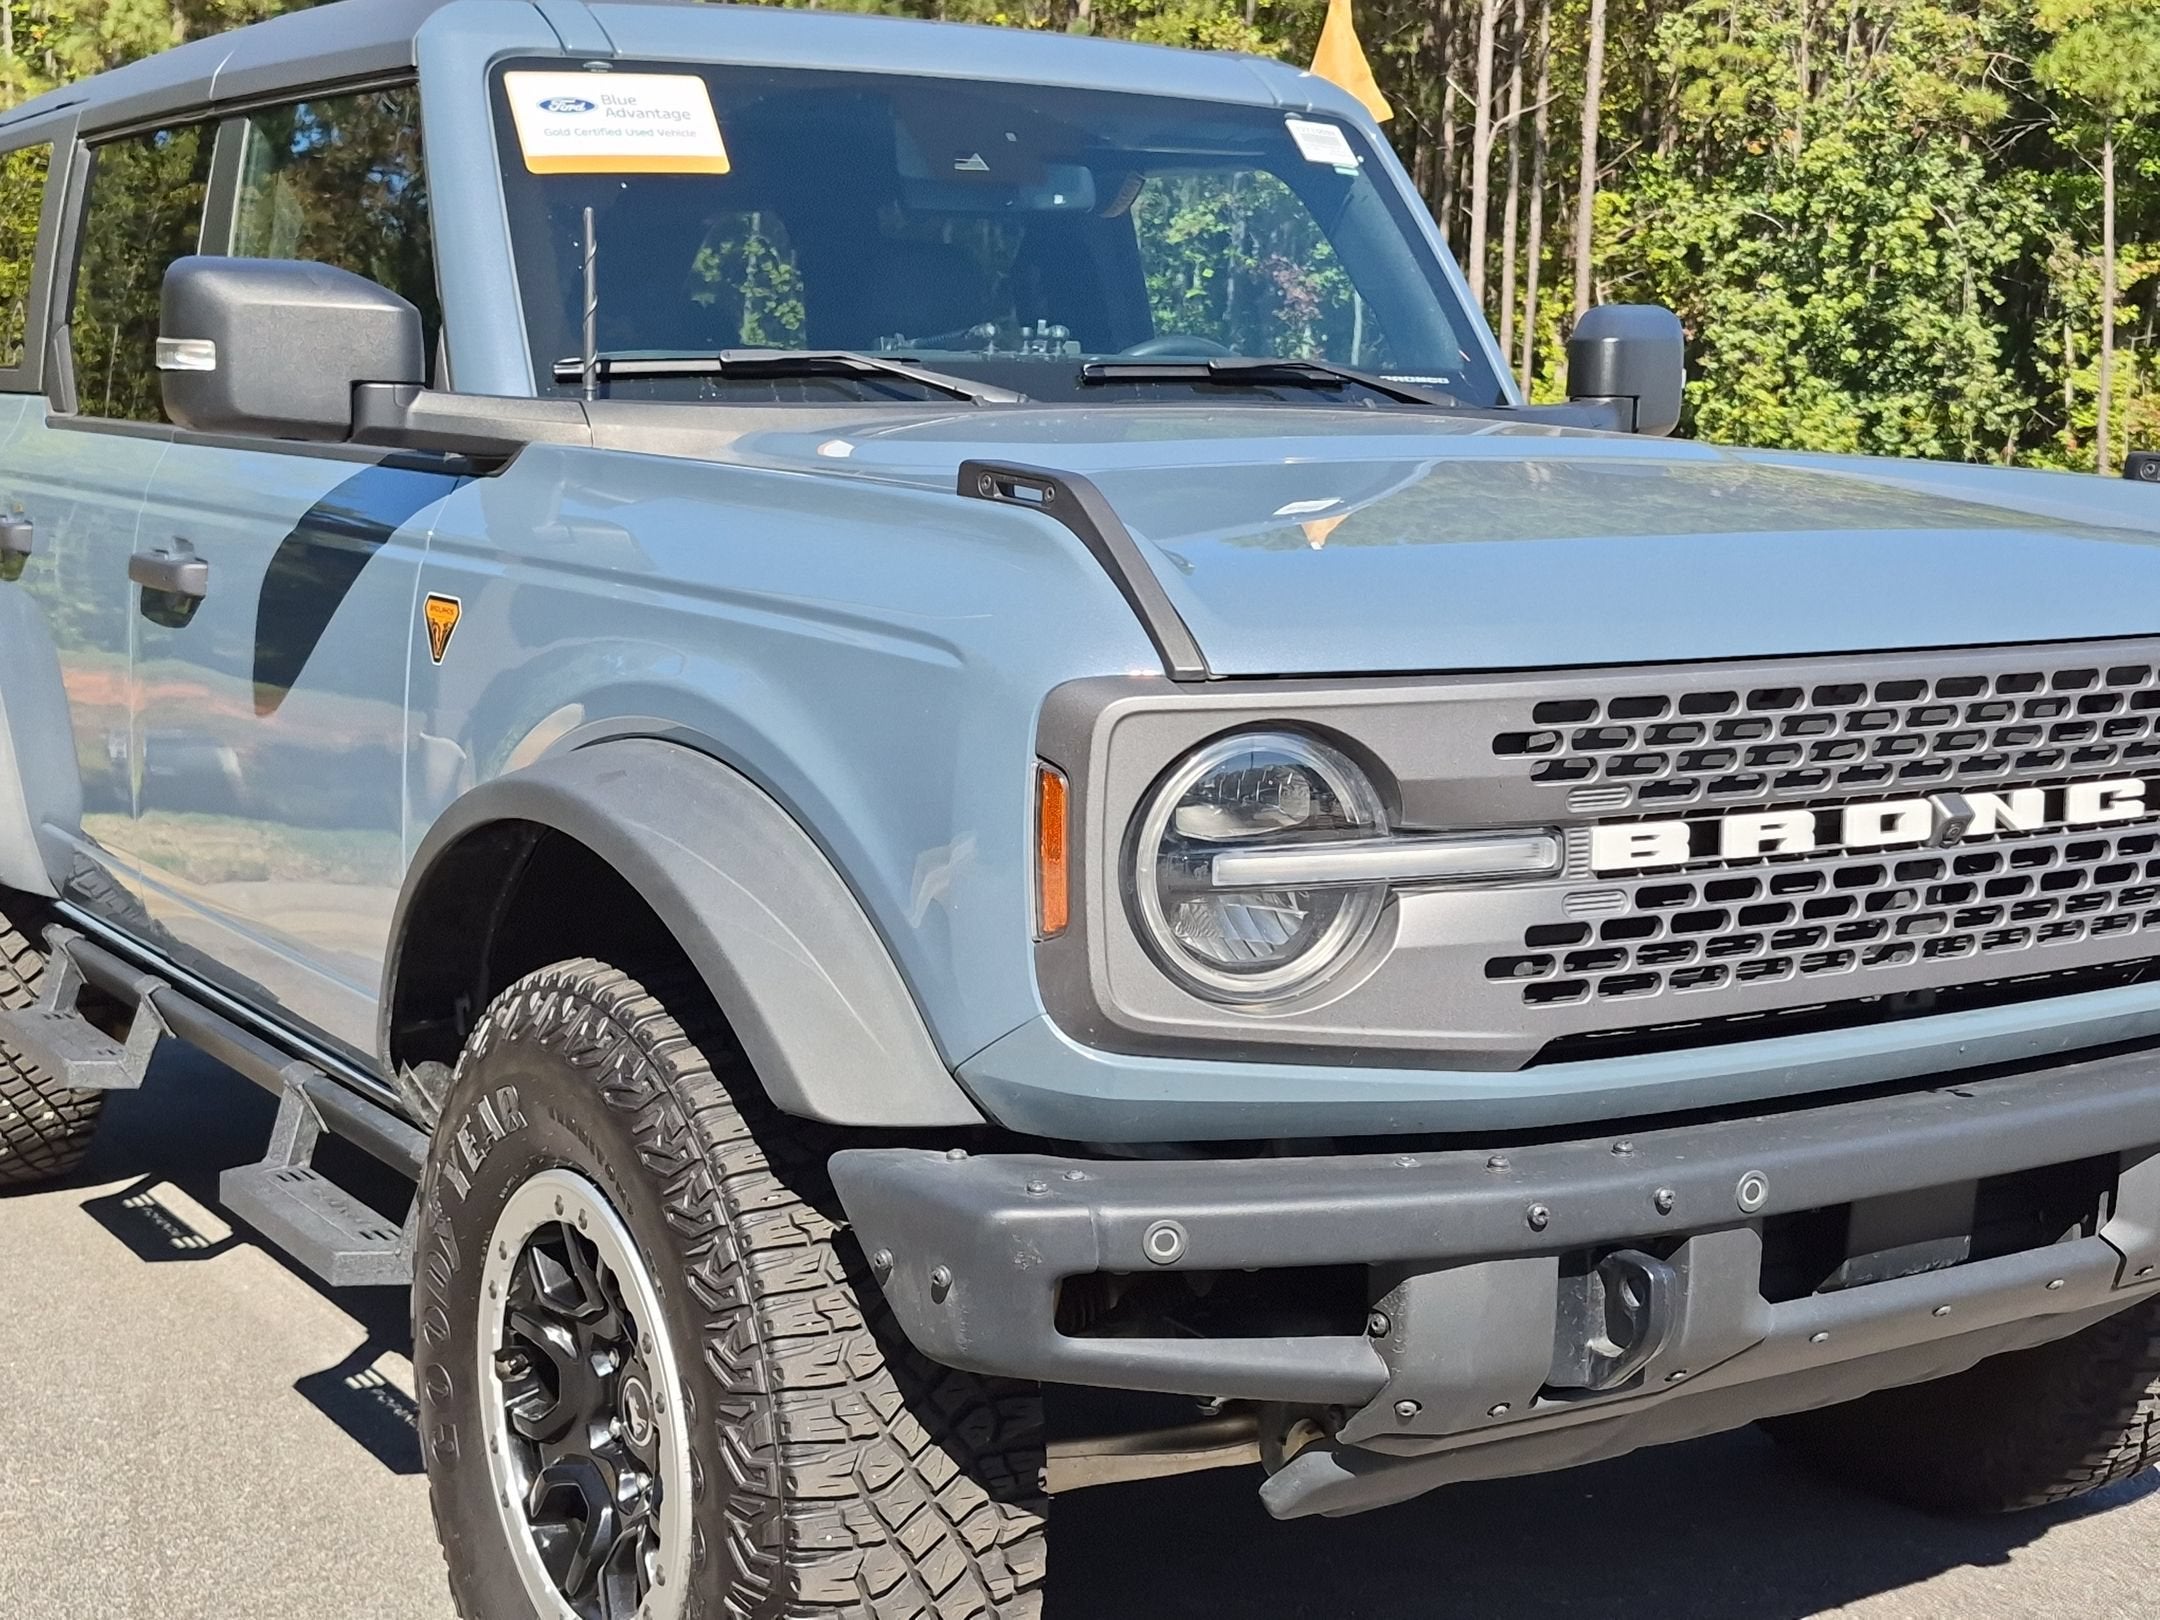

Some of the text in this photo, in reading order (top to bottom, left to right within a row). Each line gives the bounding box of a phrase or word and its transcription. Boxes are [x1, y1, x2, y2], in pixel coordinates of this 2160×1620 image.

[545, 98, 590, 113] Ford
[600, 94, 638, 106] Blue
[604, 107, 692, 122] Advantage
[543, 127, 698, 138] Gold Certified Used Vehicle
